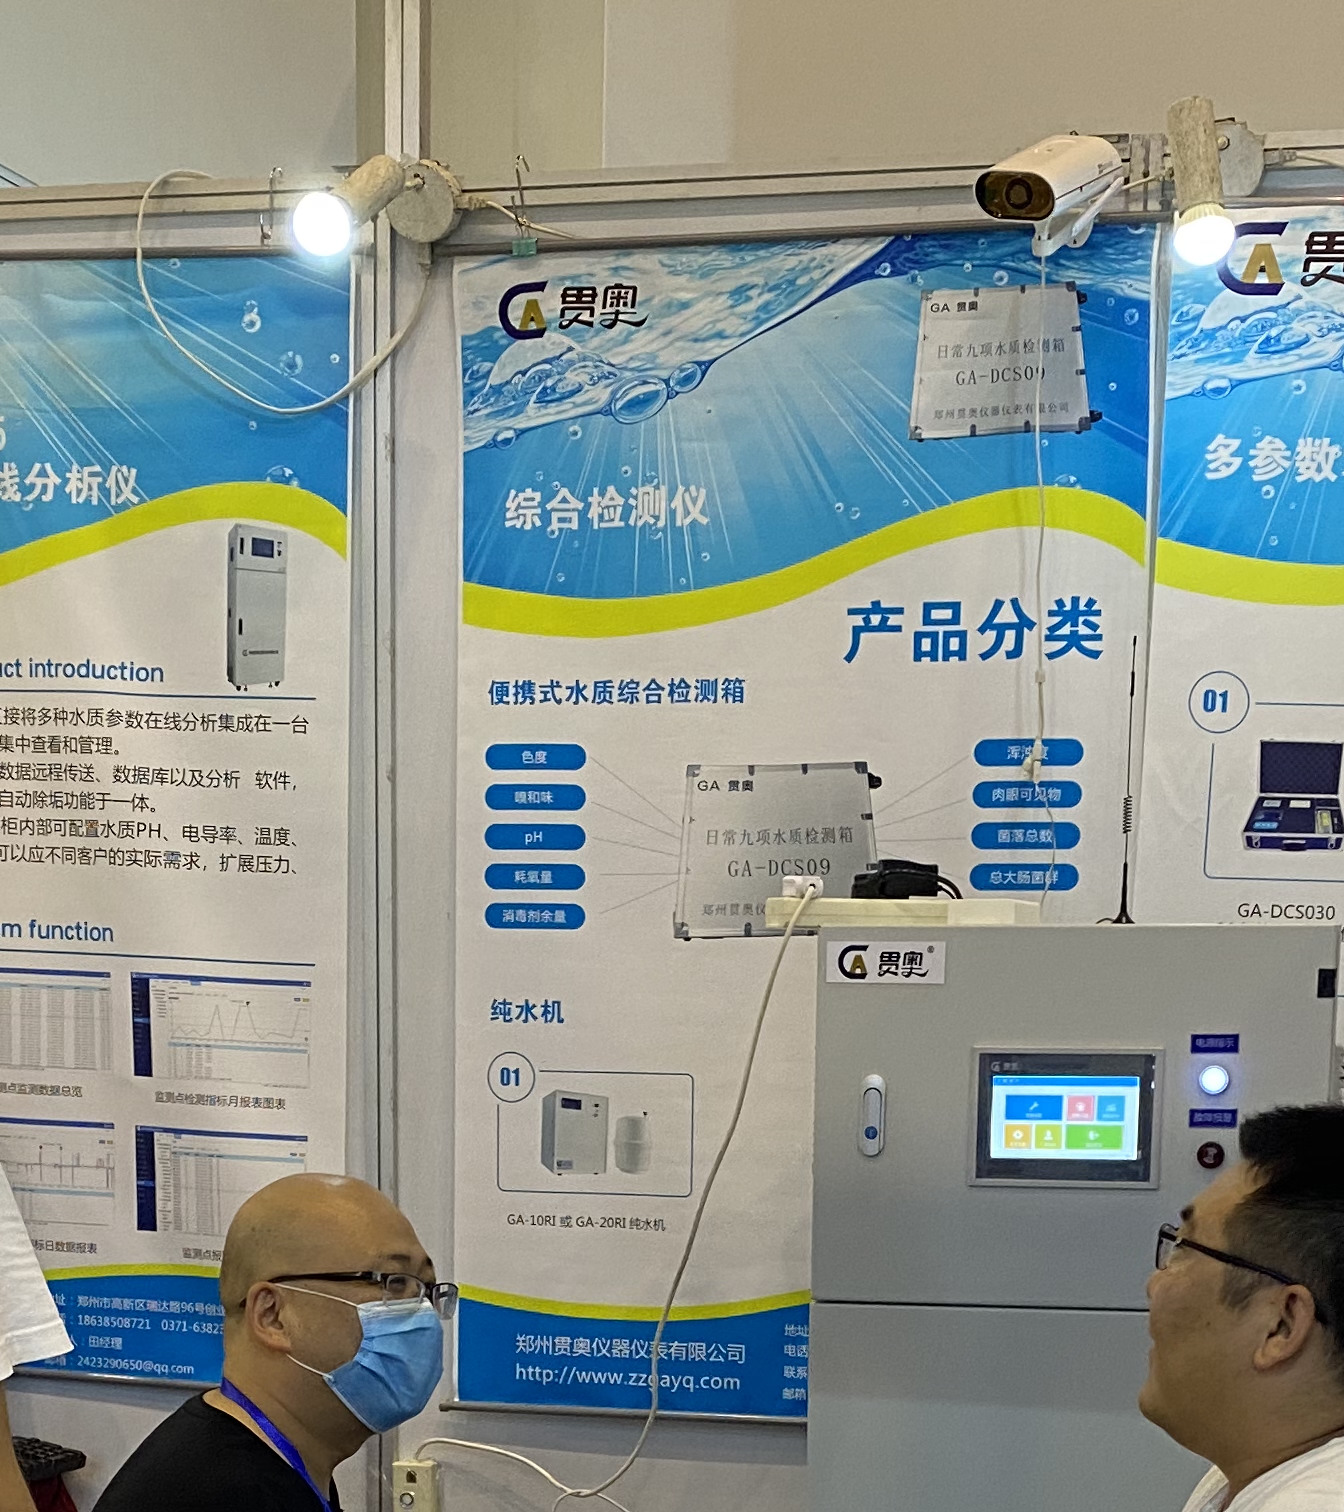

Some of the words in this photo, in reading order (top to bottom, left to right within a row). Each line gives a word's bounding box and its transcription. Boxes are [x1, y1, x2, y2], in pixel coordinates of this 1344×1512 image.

[557, 283, 649, 330] 贯奥
[929, 302, 951, 315] GA
[505, 486, 710, 532] 综合检测仪
[843, 595, 1104, 664] 产品分类
[29, 658, 166, 683] introduction
[487, 677, 747, 706] 便携式水质综合检测箱
[1203, 690, 1230, 714] 01
[521, 749, 548, 766] 色度
[1007, 744, 1049, 761] 浑度
[697, 780, 720, 793] GA
[728, 779, 754, 794] 贯奥
[524, 830, 543, 846] pH
[705, 825, 854, 847] 日常九项水质检测箱
[727, 857, 831, 879] GA-DCS09
[1237, 902, 1337, 921] GA-DCS030
[29, 918, 115, 944] function
[877, 949, 930, 980] 贯奥
[490, 998, 565, 1025] 纯水机
[499, 1067, 521, 1087] 01
[507, 1213, 557, 1228] GA-10RI
[575, 1216, 627, 1231] GA-20RI
[515, 1333, 746, 1364] 郑州贯奥仪器仪表有限公司
